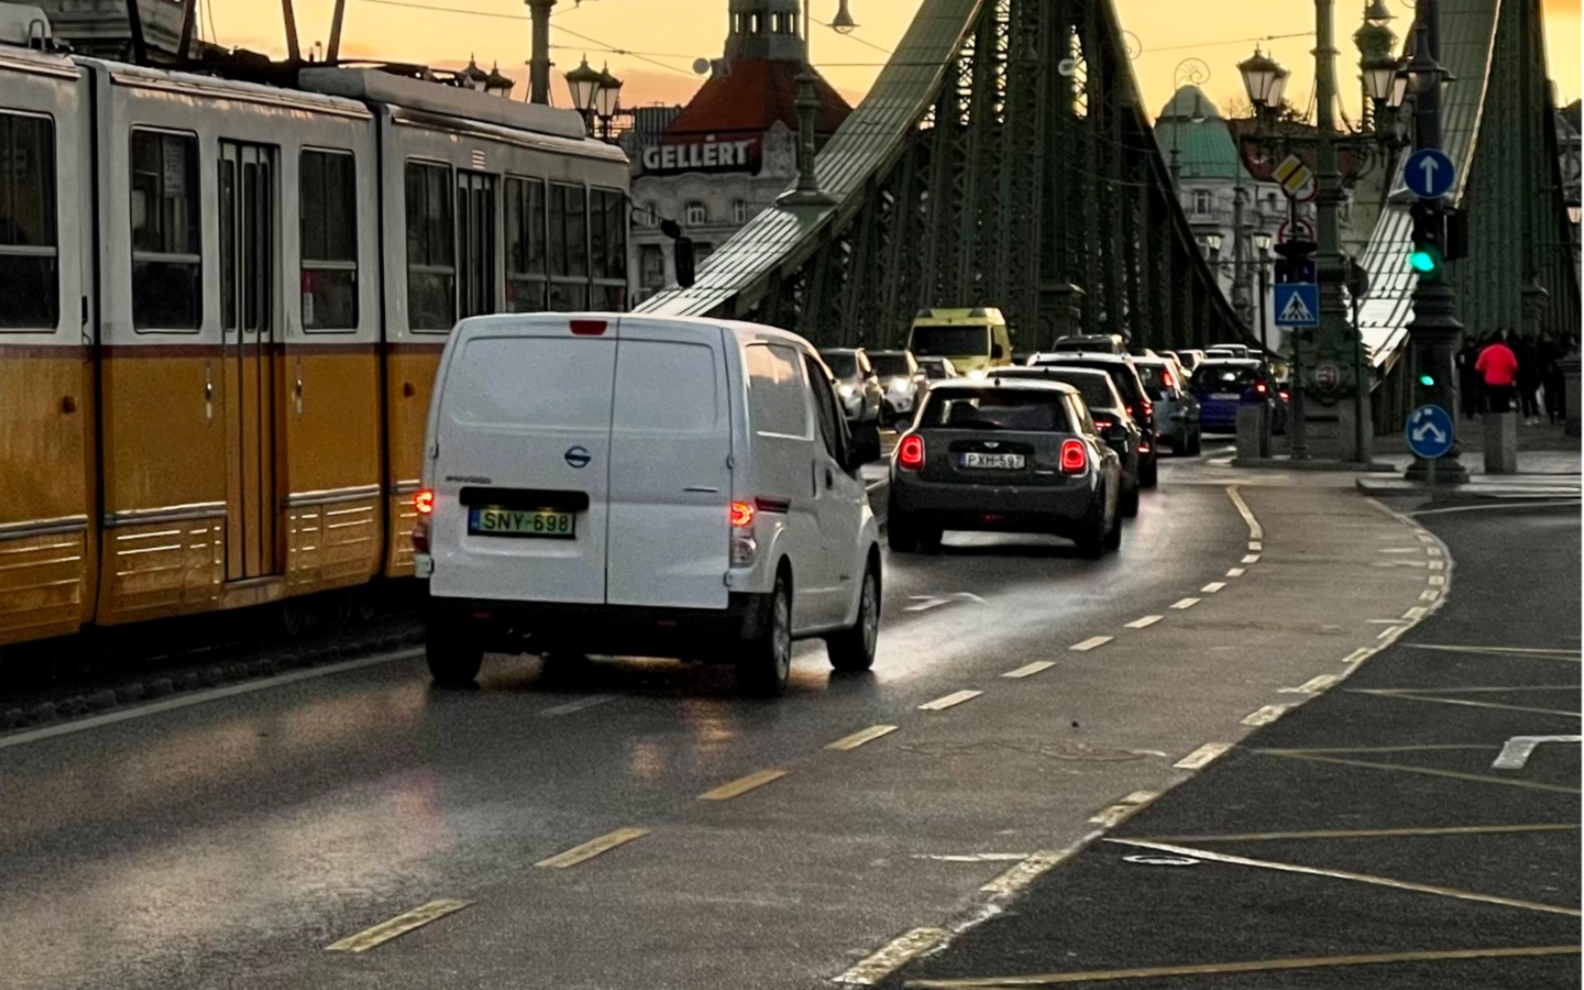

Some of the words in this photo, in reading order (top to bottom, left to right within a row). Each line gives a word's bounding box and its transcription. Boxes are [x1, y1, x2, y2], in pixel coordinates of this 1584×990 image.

[643, 134, 750, 170] GELLÉRT
[968, 454, 1023, 467] PXH-597
[483, 512, 569, 533] SNY-698
